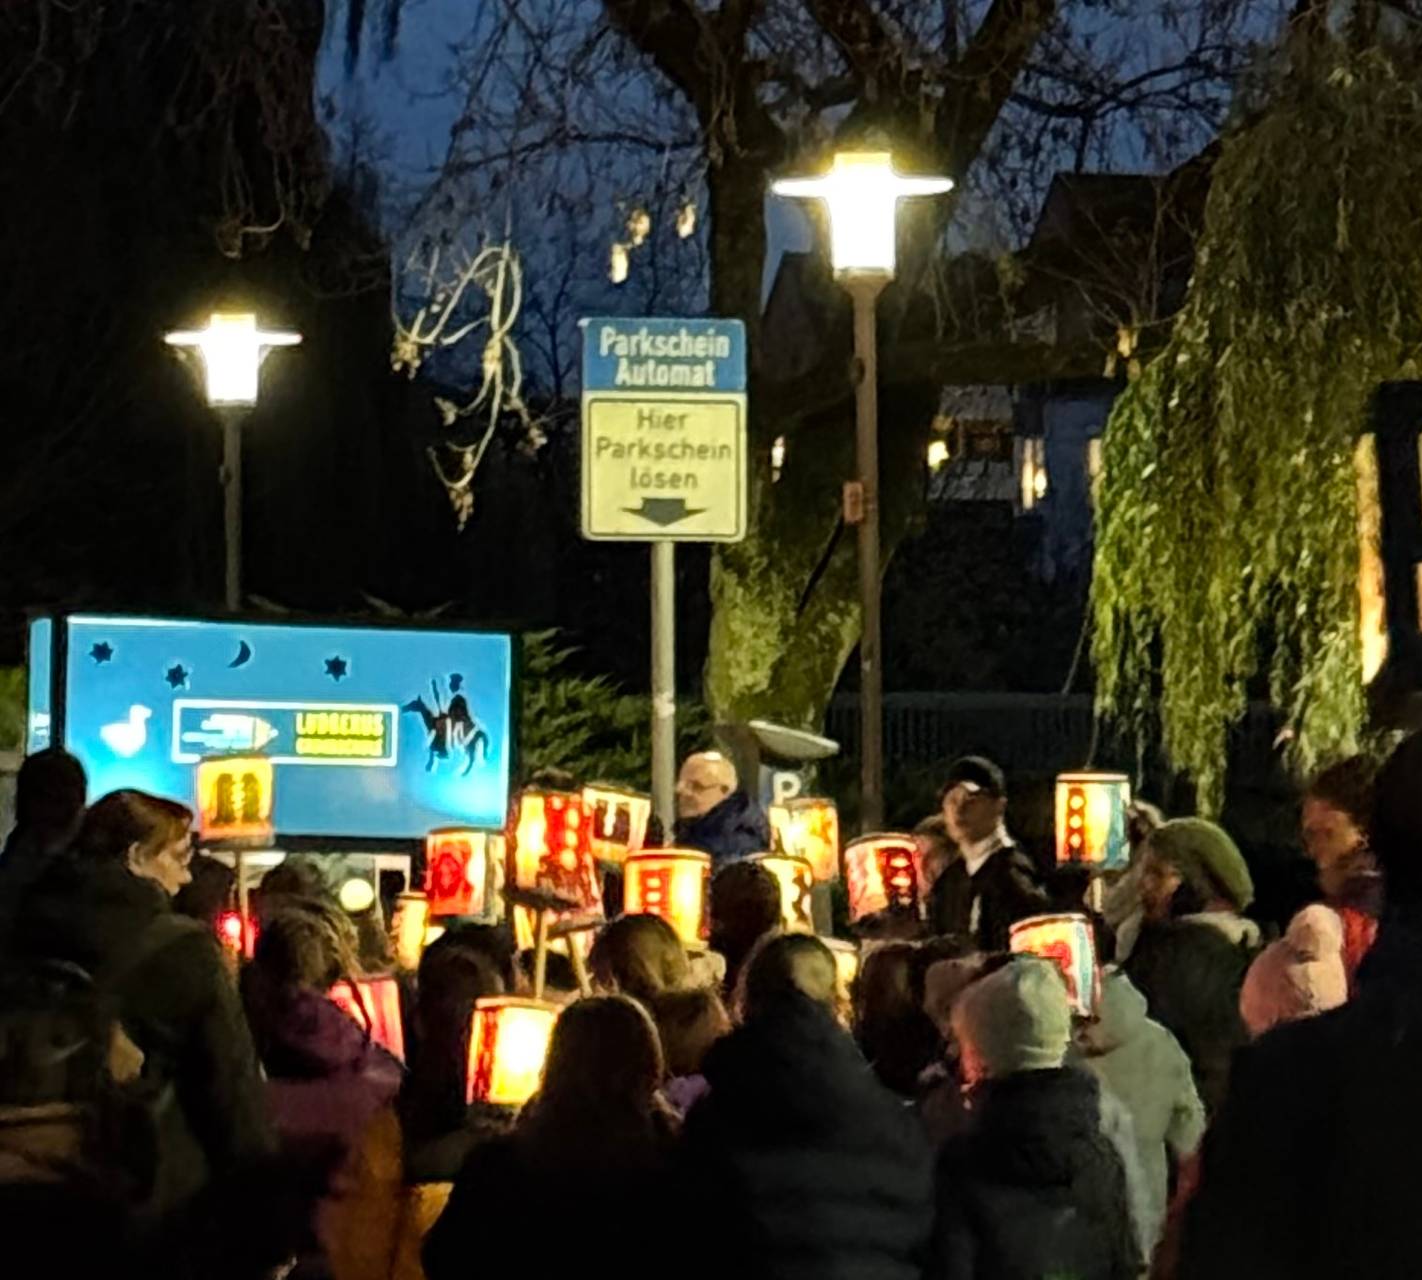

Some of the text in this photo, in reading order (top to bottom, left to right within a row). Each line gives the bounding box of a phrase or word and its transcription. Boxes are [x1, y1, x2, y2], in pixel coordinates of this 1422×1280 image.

[600, 326, 730, 358] Parkschein
[615, 359, 716, 386] Automat
[637, 409, 688, 430] Hier
[596, 436, 731, 461] Parkschein
[629, 467, 698, 490] lösen
[773, 771, 801, 806] P
